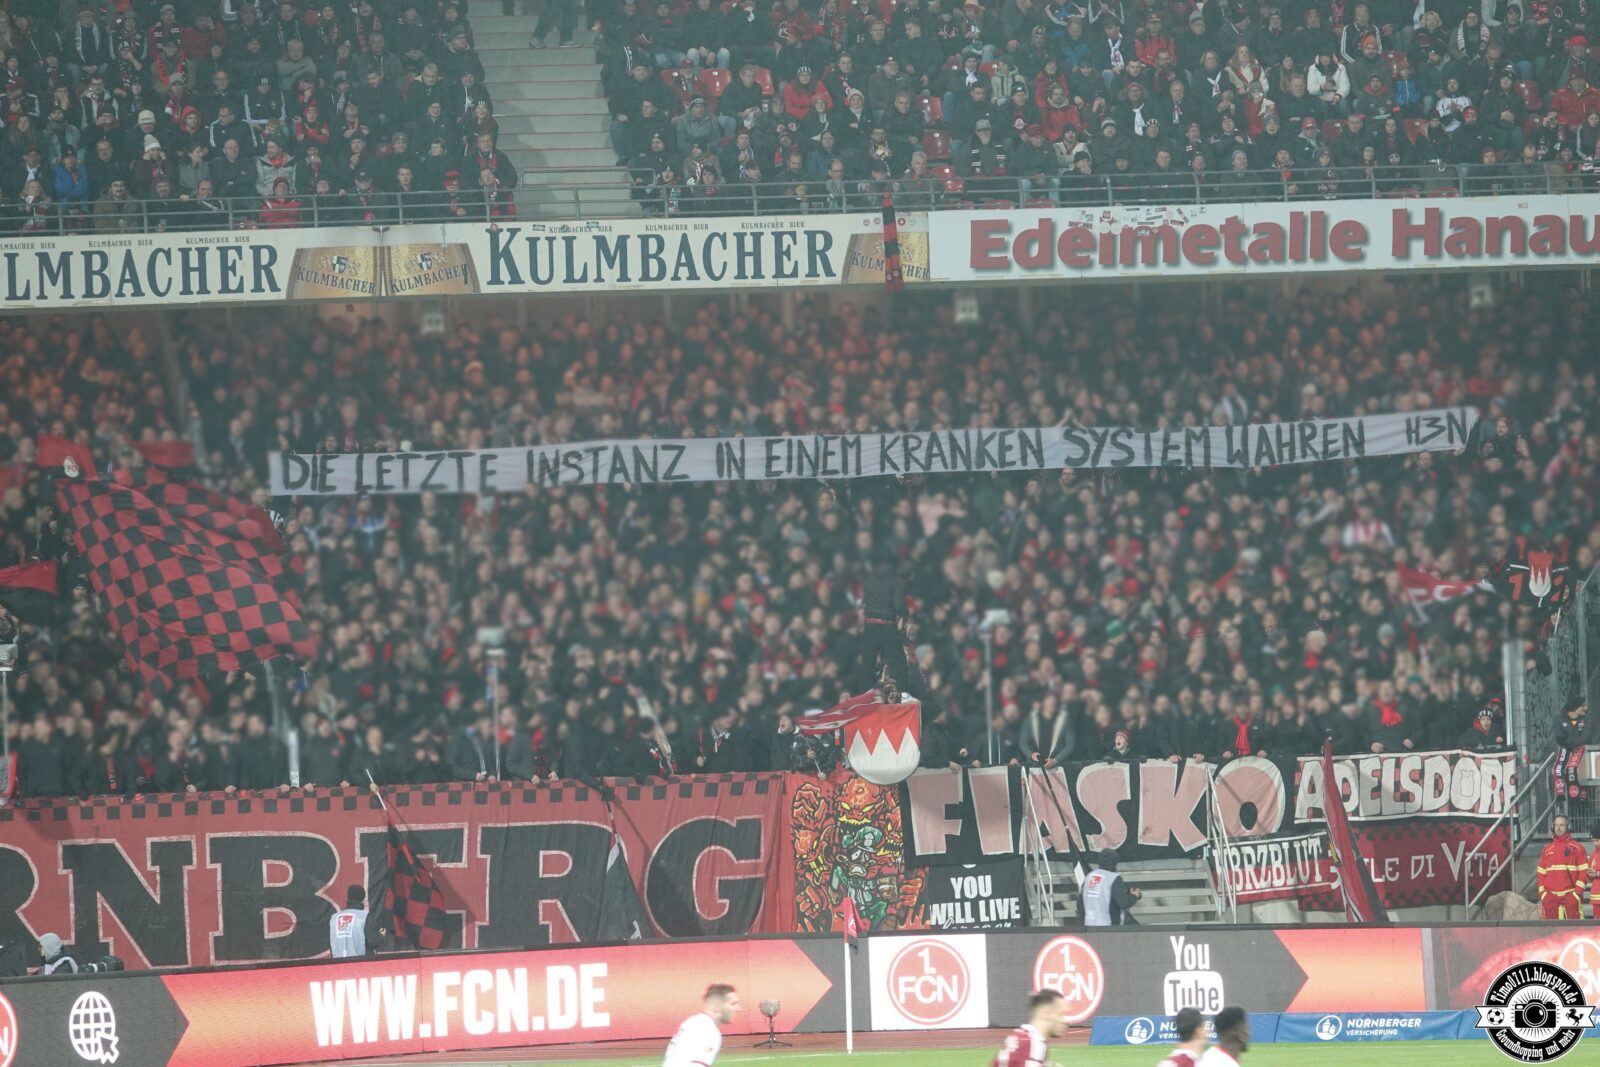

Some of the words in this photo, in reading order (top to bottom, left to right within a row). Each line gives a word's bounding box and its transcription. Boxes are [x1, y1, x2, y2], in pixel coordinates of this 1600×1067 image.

[88, 239, 132, 247] KULMBACHER
[185, 236, 229, 245] KULMBACHER
[969, 211, 1366, 269] Edelmetalle
[1392, 207, 1600, 257] Hanau
[485, 228, 836, 285] KULMBACHER
[851, 252, 930, 280] KULMCHER
[4, 244, 281, 301] LMBACHER
[297, 266, 376, 294] KULMBACHER
[283, 453, 337, 493] DIE
[355, 451, 498, 493] LETZTE
[526, 445, 690, 485] INSTANZ
[716, 440, 745, 479] IN
[765, 434, 861, 478] EINEM
[880, 429, 1045, 472] KRANKEN
[1063, 427, 1211, 467] SYSTEM
[1226, 419, 1366, 468] WAHREN
[1406, 408, 1468, 446] H3N
[906, 756, 1286, 856] FIASKO
[1411, 854, 1434, 880] DI
[950, 875, 992, 899] YOU
[929, 901, 975, 925] WILL
[979, 897, 1020, 922] LIVE
[917, 947, 937, 974] 1.
[1170, 935, 1210, 970] You
[898, 974, 958, 1004] FCN
[1043, 972, 1094, 1002] FCN
[1169, 979, 1219, 1012] Tube
[310, 963, 610, 1047] WWW.FCN.DE
